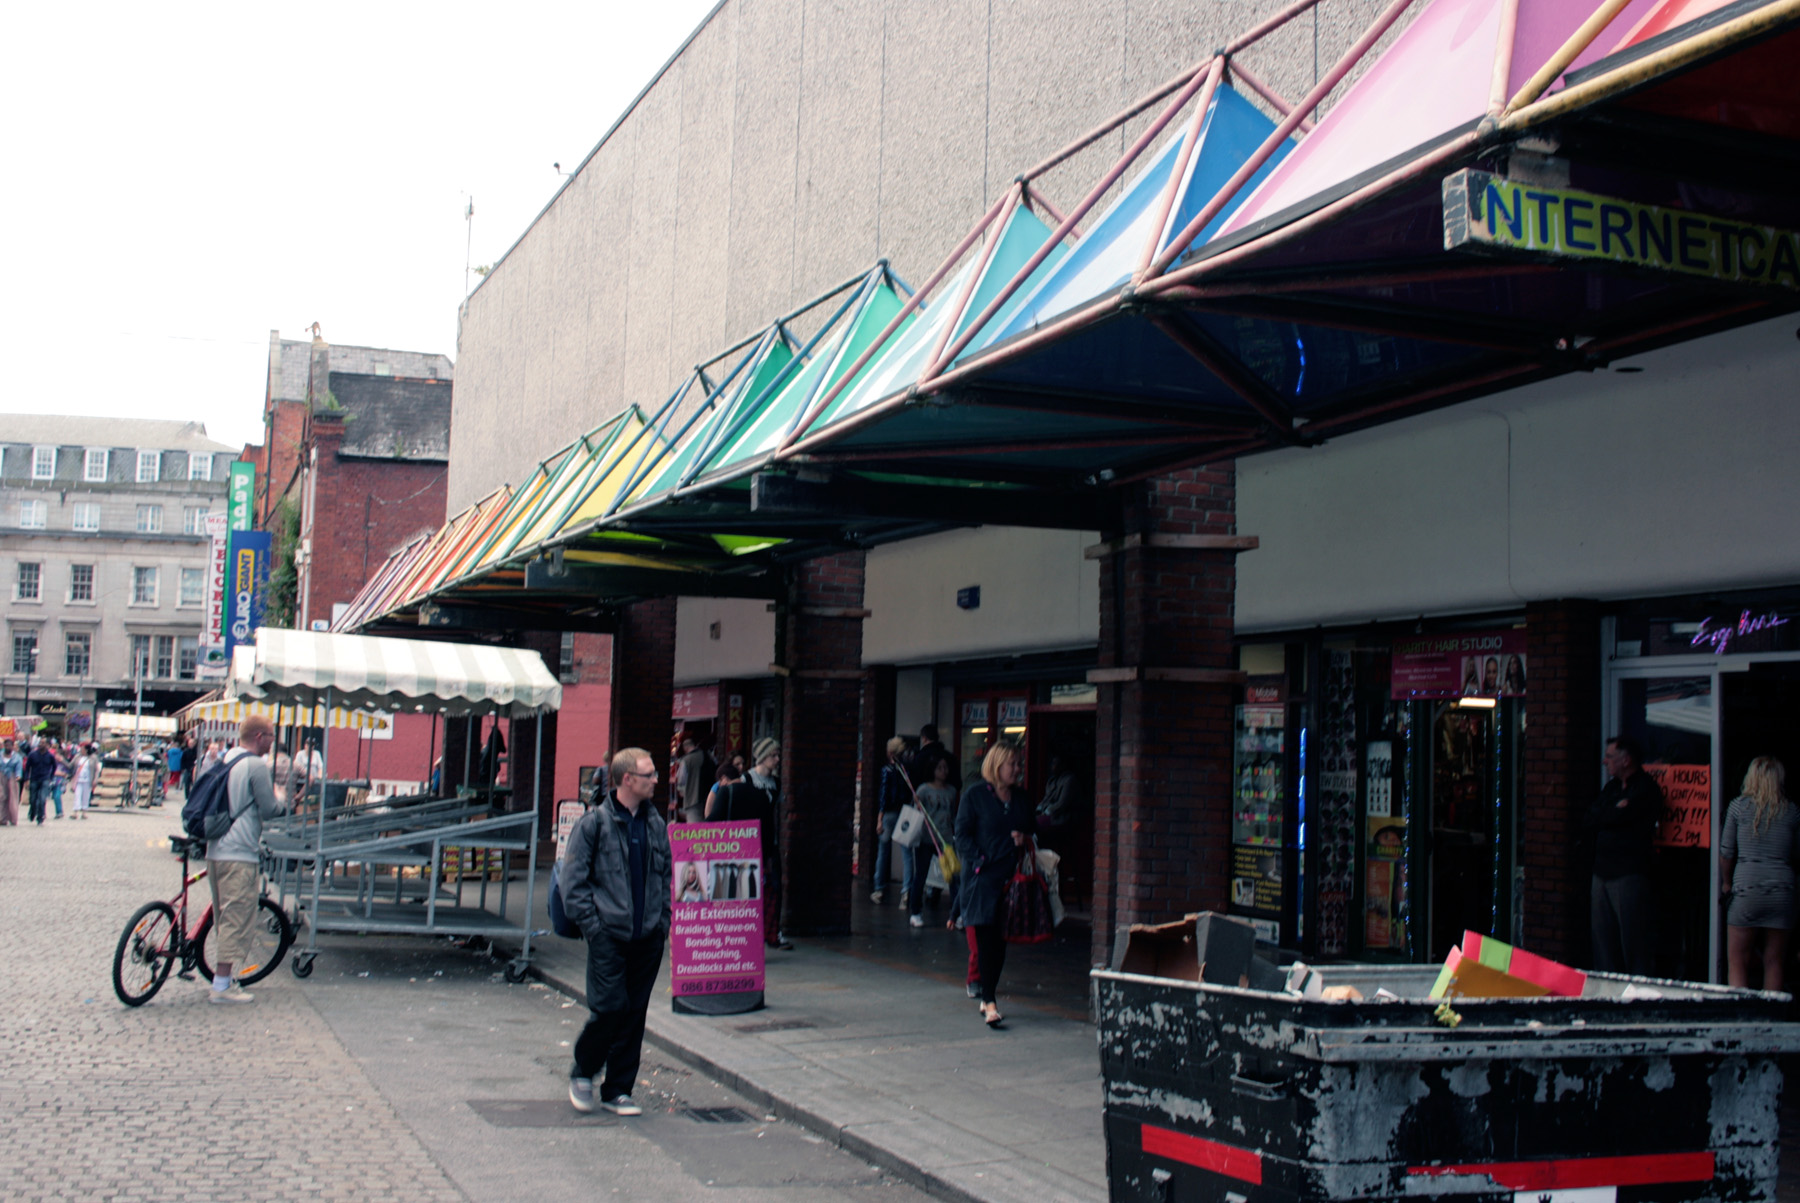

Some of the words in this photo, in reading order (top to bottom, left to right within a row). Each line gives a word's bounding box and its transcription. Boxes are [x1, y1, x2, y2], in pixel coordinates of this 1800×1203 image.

[240, 553, 252, 590] GIANT
[1393, 640, 1433, 654] CHARITY
[1435, 639, 1459, 652] HAIR
[1461, 636, 1503, 651] STUDIO
[729, 709, 742, 748] KEY
[1673, 770, 1708, 785] HOURS
[673, 828, 726, 840] CHARITY
[729, 827, 758, 839] HAIR
[1672, 825, 1683, 842] 2
[1686, 831, 1701, 844] PM
[692, 841, 740, 854] STUDIO
[675, 907, 698, 921] Hair
[700, 906, 759, 920] Extensions,
[675, 924, 712, 936] Braiding,
[685, 937, 723, 948] Bonding,
[724, 935, 748, 946] Perm,
[692, 948, 741, 960] Retouching,
[677, 962, 723, 974] Dreadlocks
[724, 961, 741, 972] and
[742, 960, 757, 971] etc.
[681, 981, 703, 993] 086
[705, 978, 755, 992] 8738299
